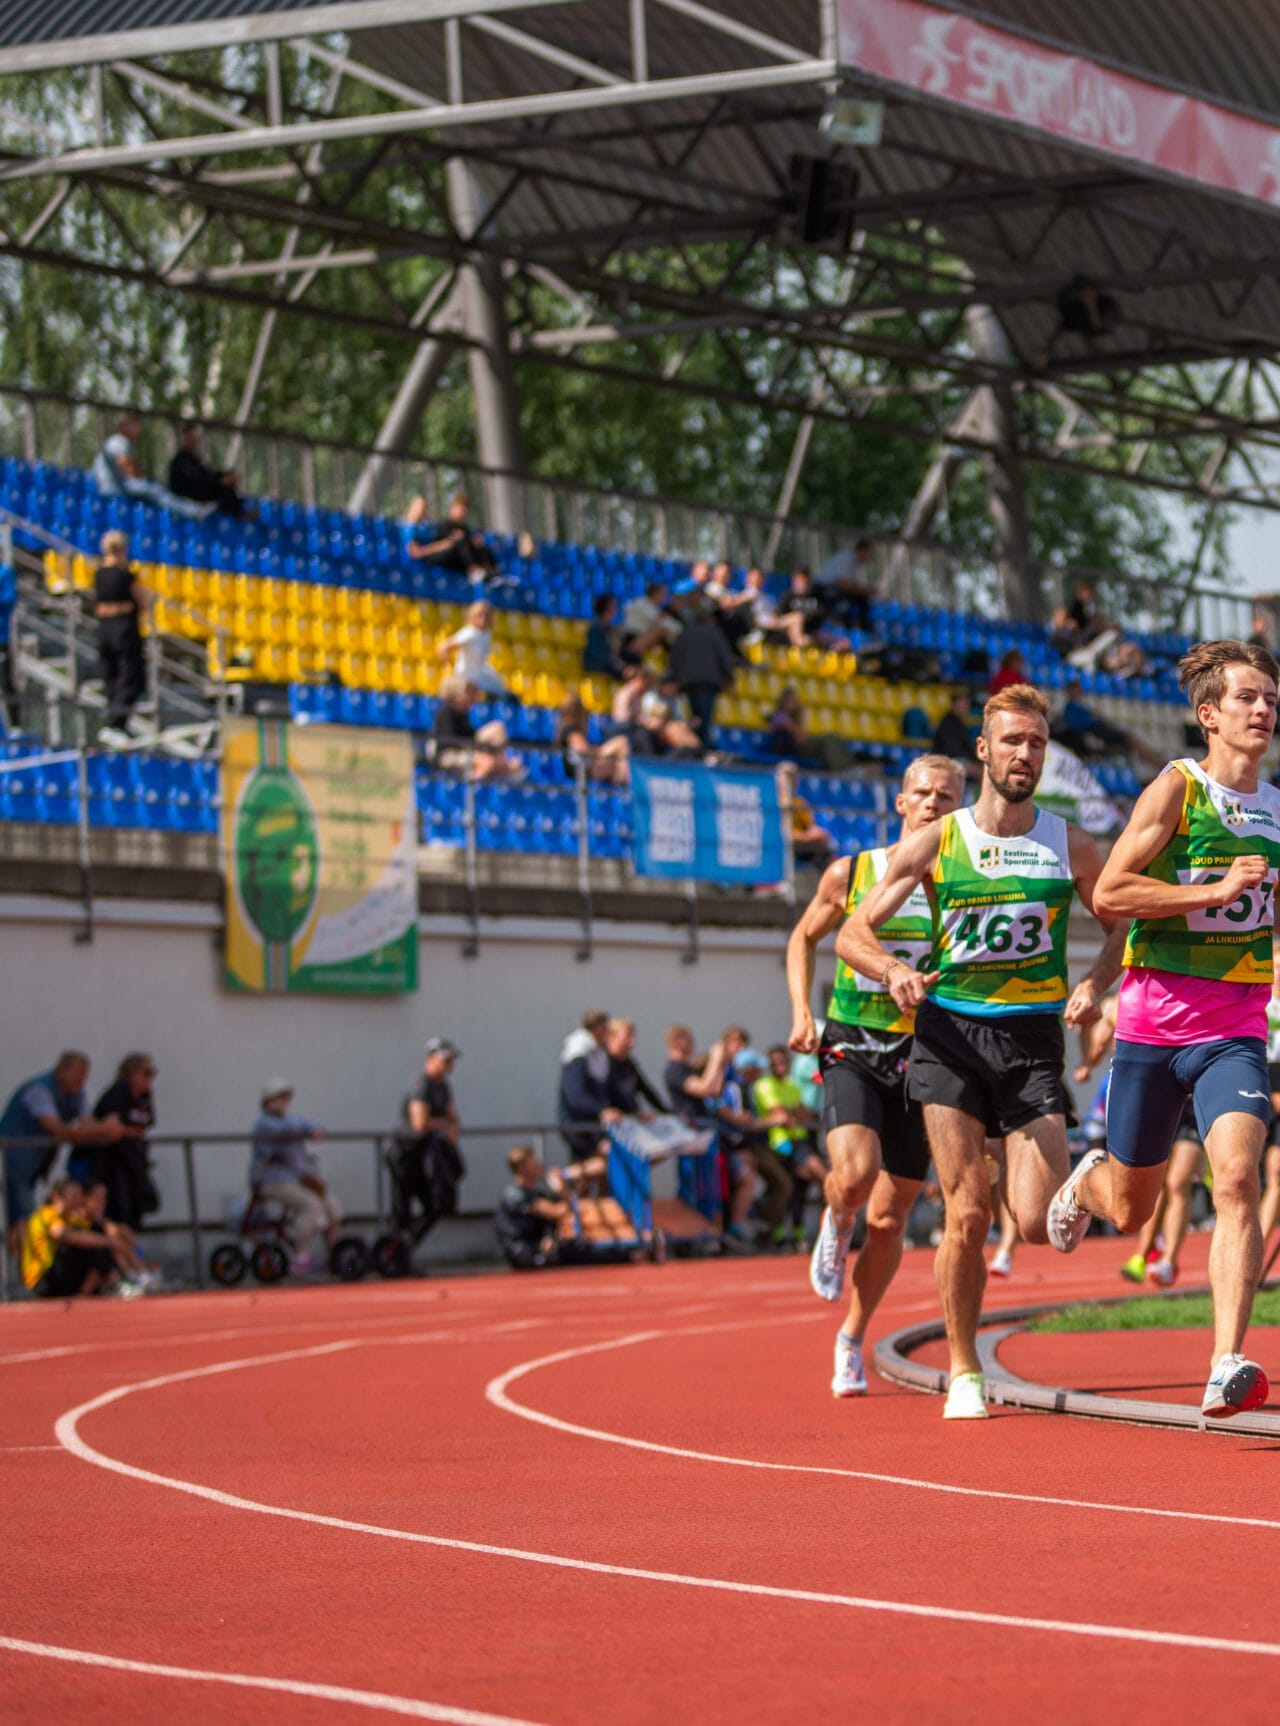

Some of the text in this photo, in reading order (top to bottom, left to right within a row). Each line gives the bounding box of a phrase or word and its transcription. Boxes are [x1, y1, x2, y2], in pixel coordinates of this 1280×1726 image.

[1003, 849, 1038, 857] Eestimaa
[1003, 858, 1059, 867] Spordiliit Jõud
[1190, 855, 1213, 865] JÕUD
[955, 913, 1043, 954] 463
